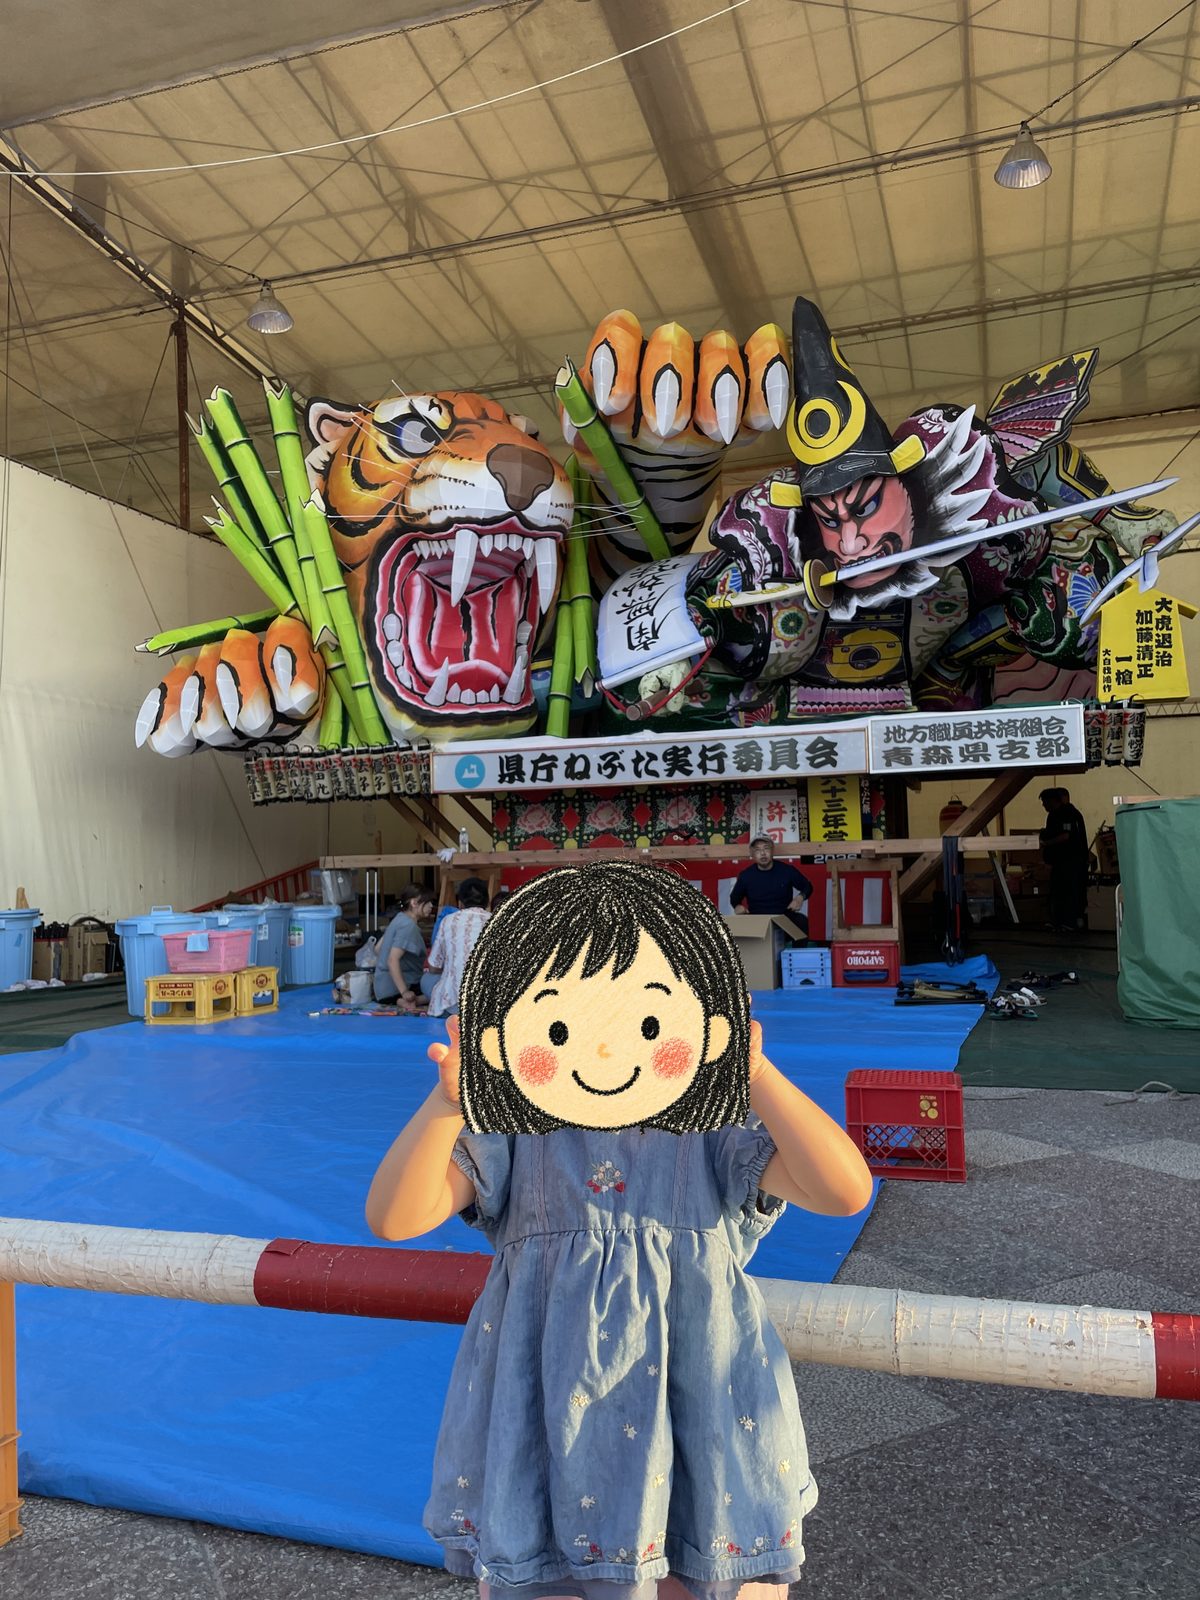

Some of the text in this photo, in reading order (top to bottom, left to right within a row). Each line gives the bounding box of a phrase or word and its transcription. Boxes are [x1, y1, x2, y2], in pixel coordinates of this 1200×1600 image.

[1136, 610, 1154, 679] 加藤清正
[1154, 597, 1173, 667] 大虎退治
[1115, 655, 1134, 686] 一槍
[884, 715, 1067, 745] 地方職員共済組合
[497, 736, 839, 785] 県庁ねぶた実行委員会
[881, 736, 1071, 768] 青森県支部
[765, 800, 787, 843] 許可
[847, 956, 885, 966] SAPPORO
